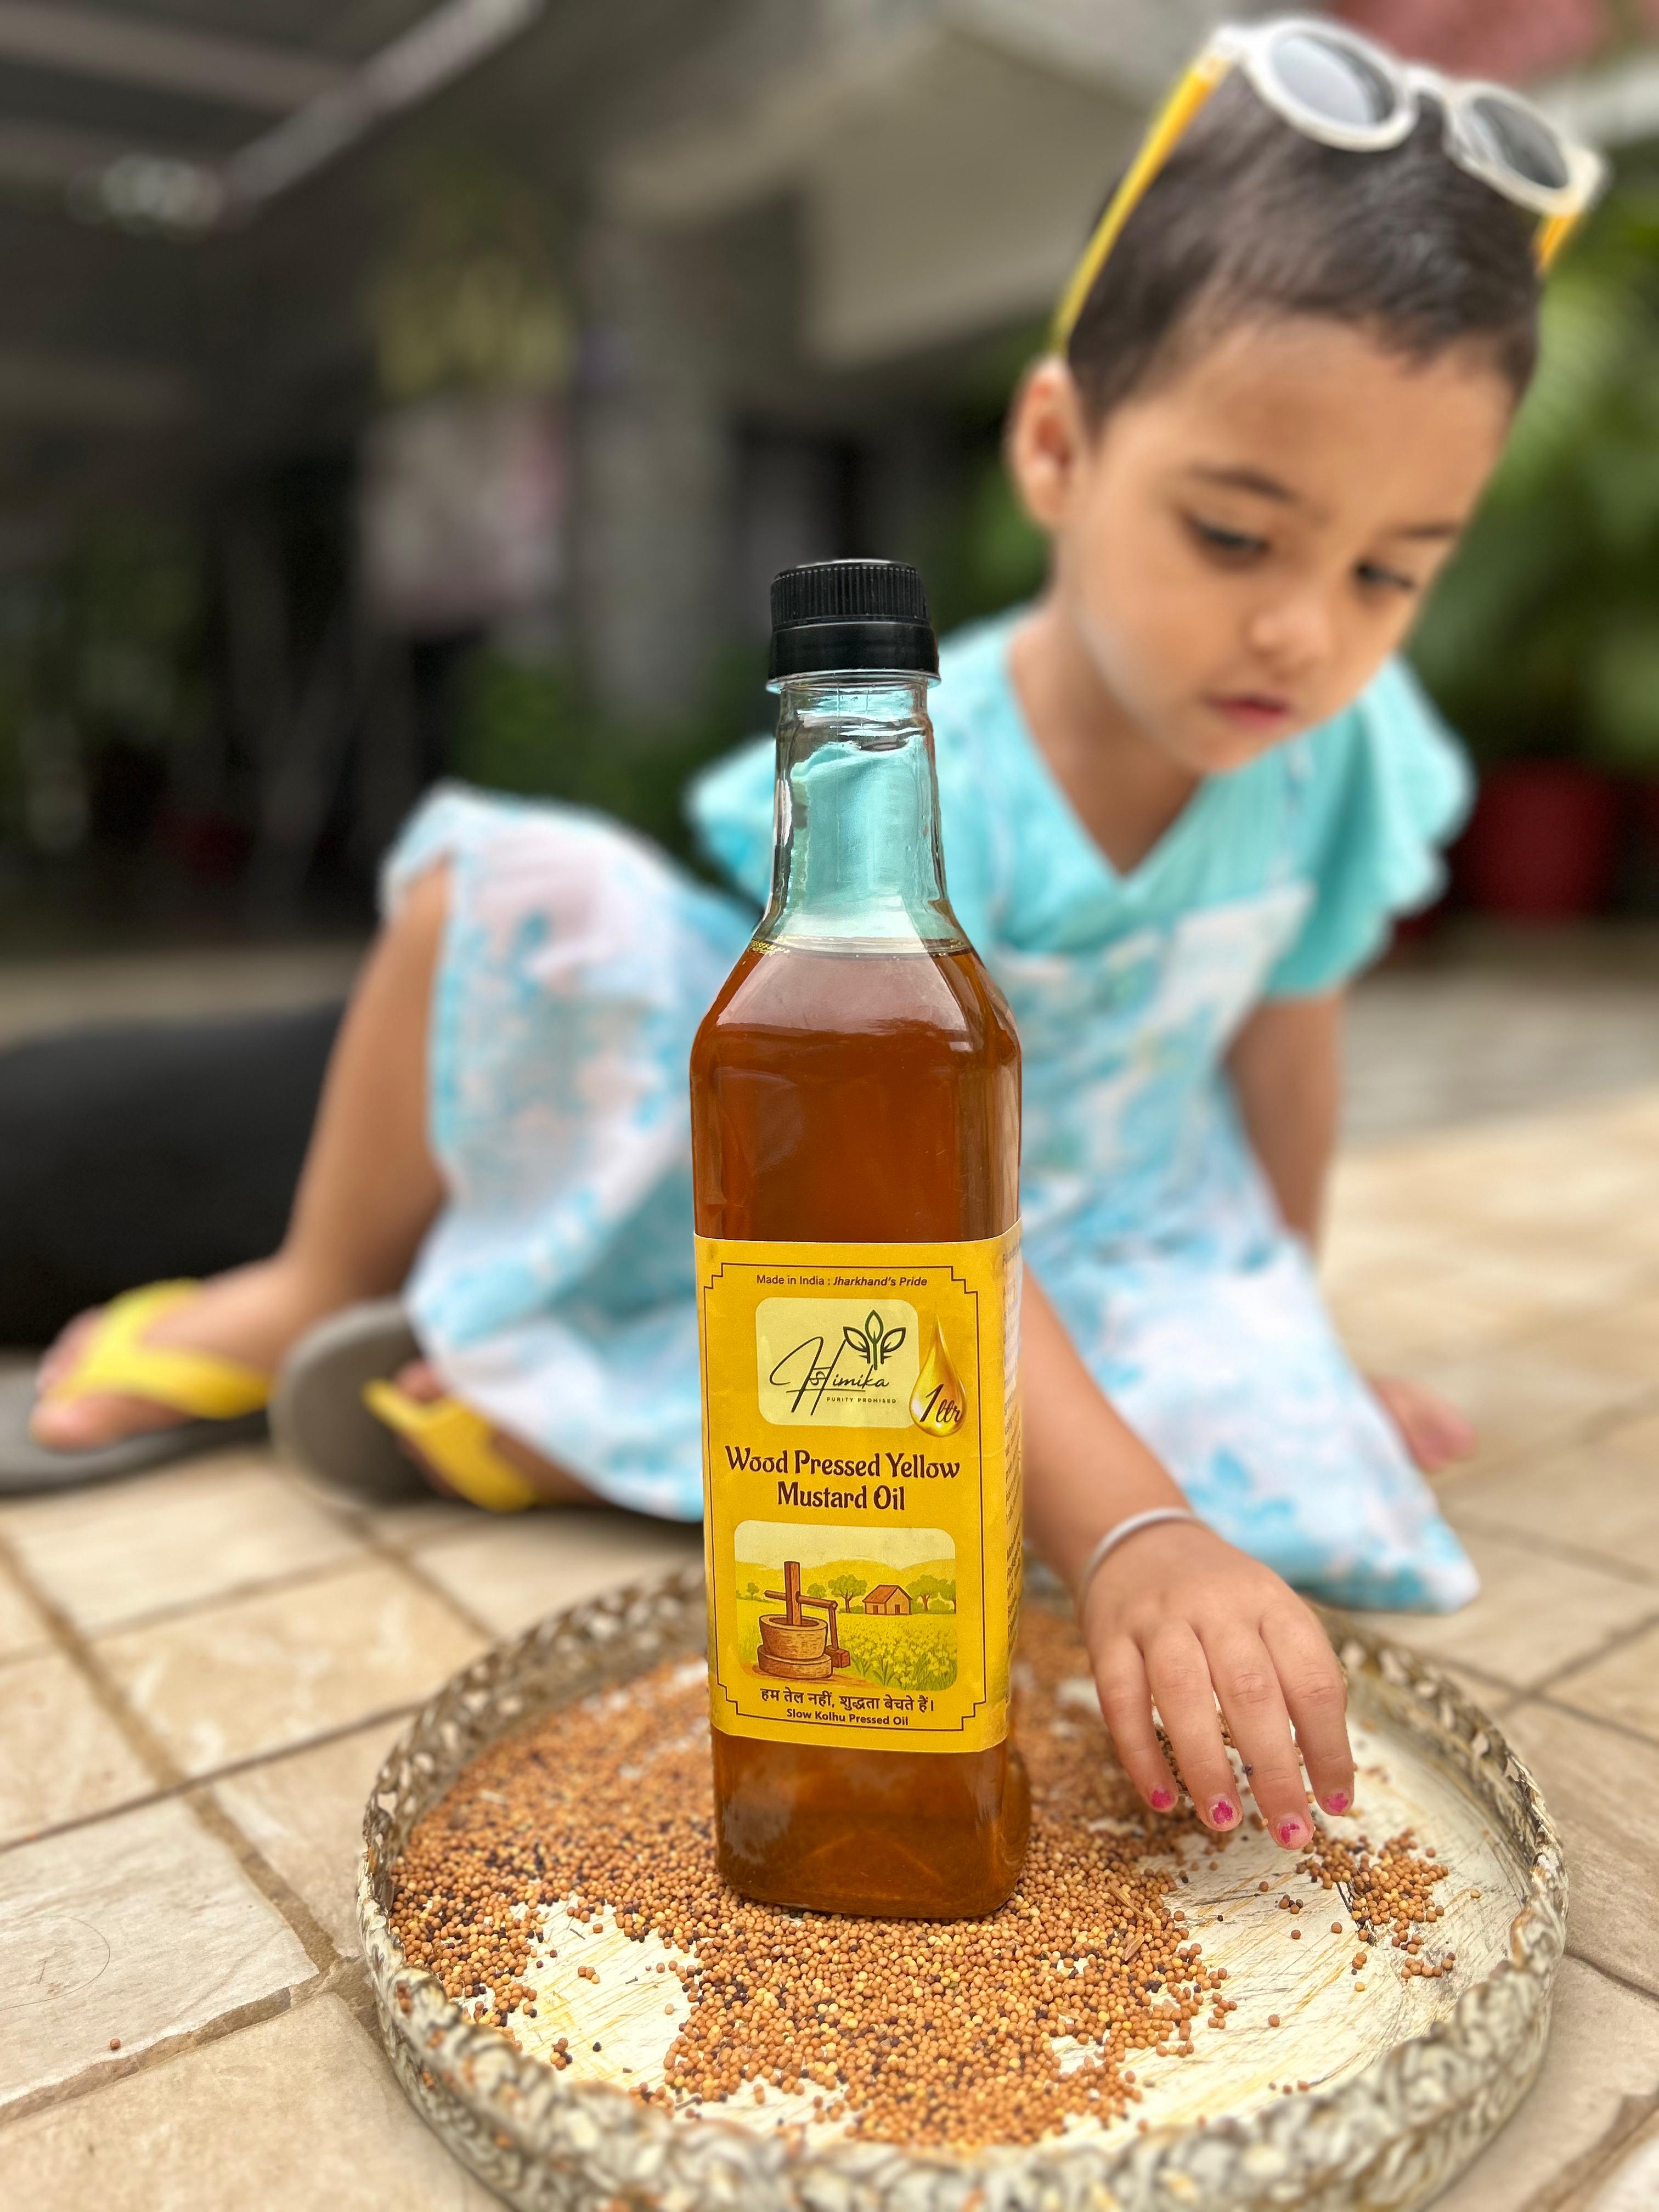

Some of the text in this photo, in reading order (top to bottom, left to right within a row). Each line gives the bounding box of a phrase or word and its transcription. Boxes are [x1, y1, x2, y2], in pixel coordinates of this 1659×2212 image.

[757, 1274, 785, 1285] Made
[787, 1274, 797, 1285] in
[799, 1276, 825, 1285] India
[899, 1276, 928, 1286] Pride
[724, 1445, 960, 1479] Wood Pressed Yellow
[777, 1481, 905, 1511] Mustard Oil
[759, 1688, 780, 1702] हम
[782, 1686, 805, 1704] तेल
[883, 1694, 915, 1711] बेचते
[786, 1708, 909, 1726] Slow Kolhu Pressed Oil
